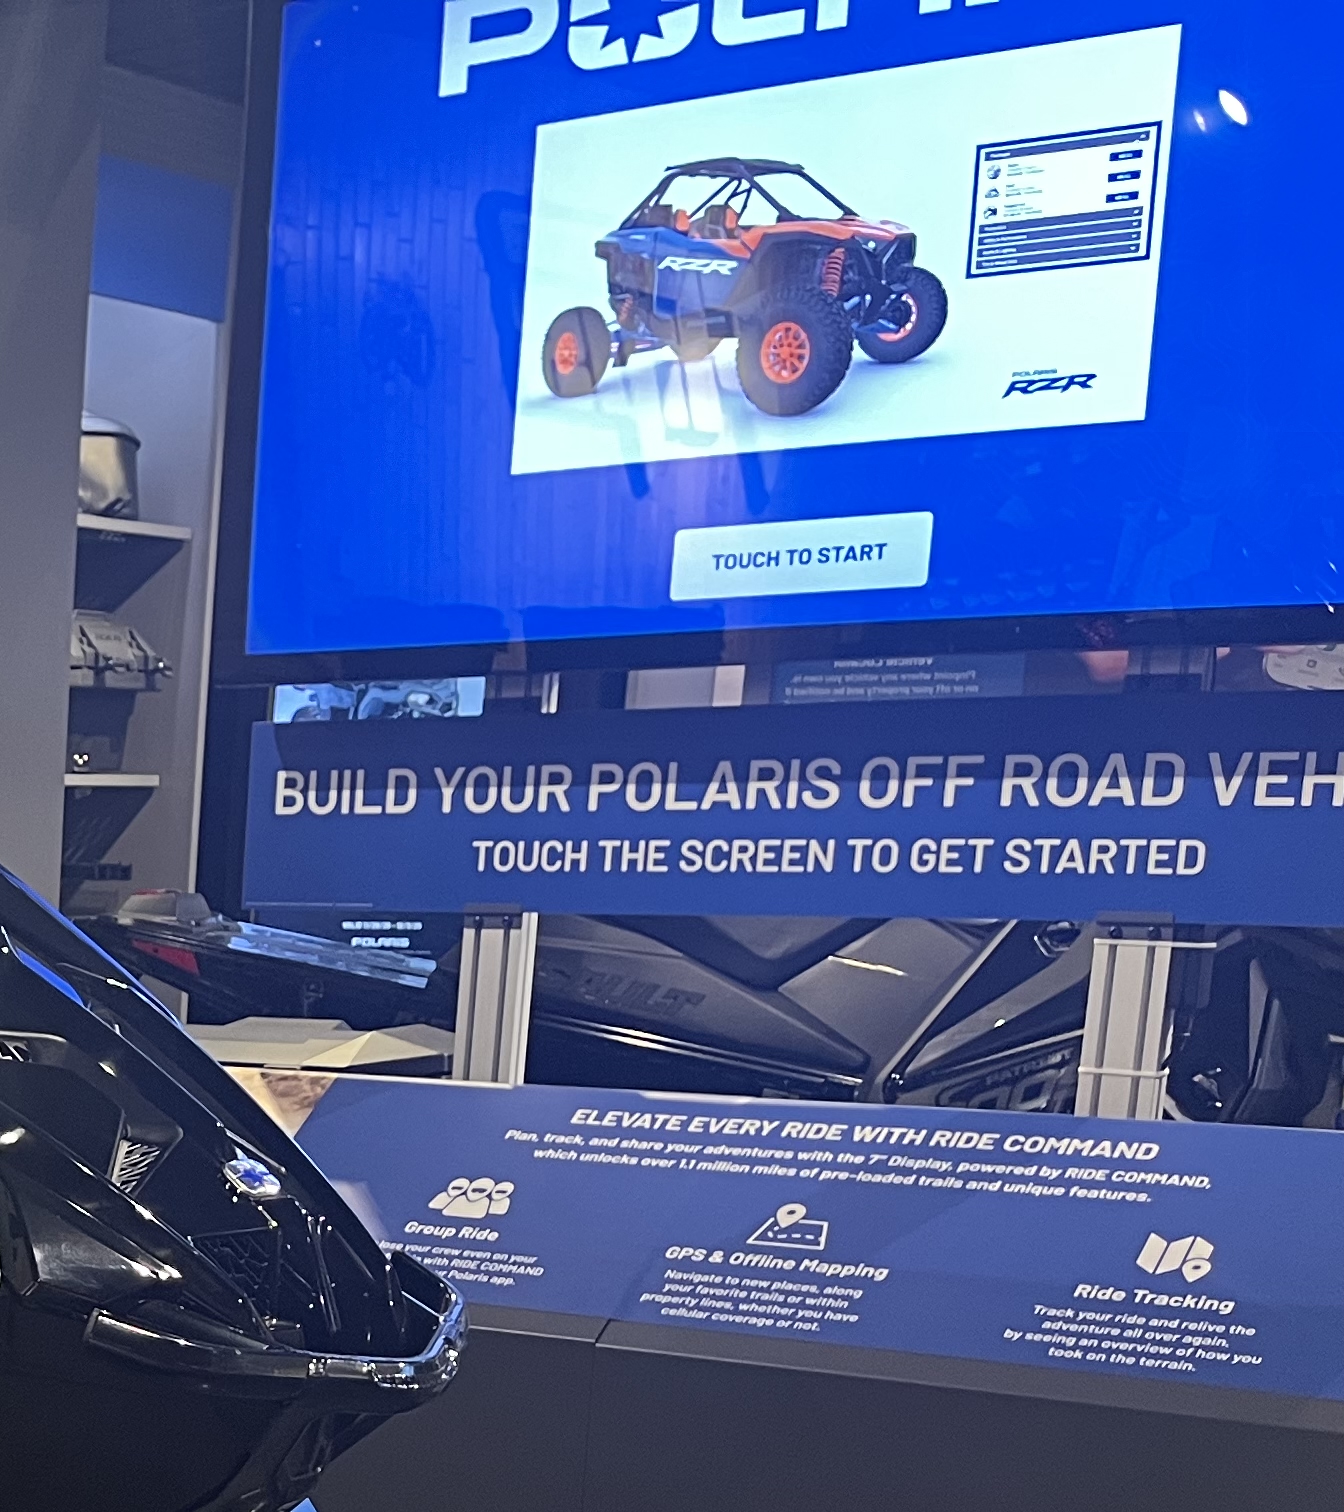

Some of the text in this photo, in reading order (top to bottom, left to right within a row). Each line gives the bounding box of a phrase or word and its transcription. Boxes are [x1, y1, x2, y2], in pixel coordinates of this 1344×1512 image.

[1001, 373, 1097, 399] RZR
[712, 542, 888, 571] TOUCH TO START
[275, 769, 417, 815] BUILD
[435, 765, 571, 813] YOUR
[588, 759, 840, 812] POLARIS
[859, 756, 980, 808] OFF
[1000, 753, 1185, 807] ROAD
[472, 838, 1206, 875] TOUCH THE SCREEN TO GET STARTED
[570, 1109, 1160, 1161] ELEVATE EVERY RIDE WITH RIDE COMMAND
[533, 1149, 577, 1161] which
[579, 1151, 638, 1165] unlocks
[641, 1156, 677, 1168] over
[678, 1158, 694, 1170] 1.1
[697, 1160, 750, 1174] million
[752, 1164, 796, 1177] miles
[798, 1168, 818, 1179] of
[818, 1170, 915, 1185] pre-loaded
[918, 1174, 963, 1188] trails
[966, 1178, 1000, 1192] and
[1003, 1182, 1066, 1198] unique
[588, 1137, 617, 1148] and
[619, 1138, 663, 1152] share
[664, 1142, 702, 1154] your
[703, 1144, 794, 1160] adventures
[797, 1149, 834, 1163] with
[837, 1152, 865, 1165] the
[956, 1161, 1037, 1177] powered
[1039, 1166, 1063, 1179] by
[1064, 1168, 1110, 1181] RIDE
[404, 1222, 499, 1242] Group Ride
[404, 1243, 431, 1252] your
[432, 1247, 461, 1256] crew
[462, 1250, 492, 1260] even
[492, 1253, 508, 1261] on
[510, 1256, 538, 1264] your
[423, 1256, 449, 1266] with
[450, 1258, 480, 1270] RIDE
[480, 1262, 545, 1276] COMMAND
[665, 1246, 890, 1282] GPS & Offline Mapping
[448, 1270, 489, 1283] Polaris
[664, 1269, 723, 1284] Navigate
[725, 1274, 739, 1285] to
[741, 1278, 771, 1288] new
[823, 1286, 864, 1300] along
[640, 1293, 699, 1306] property
[738, 1302, 795, 1316] whether
[797, 1309, 822, 1319] you
[824, 1311, 858, 1322] have
[662, 1282, 848, 1309] your favorite trails or within
[1073, 1283, 1235, 1315] Ride Tracking
[661, 1306, 710, 1320] cellular
[712, 1311, 773, 1327] coverage
[776, 1320, 793, 1328] or
[1033, 1304, 1256, 1336] Track your ride and relive the
[1041, 1320, 1121, 1336] adventure
[1123, 1328, 1142, 1338] all
[1144, 1331, 1181, 1342] over
[1003, 1328, 1262, 1366] by seeing an overview of how you
[1048, 1347, 1083, 1360] took
[1086, 1352, 1106, 1362] on
[1109, 1354, 1136, 1365] the
